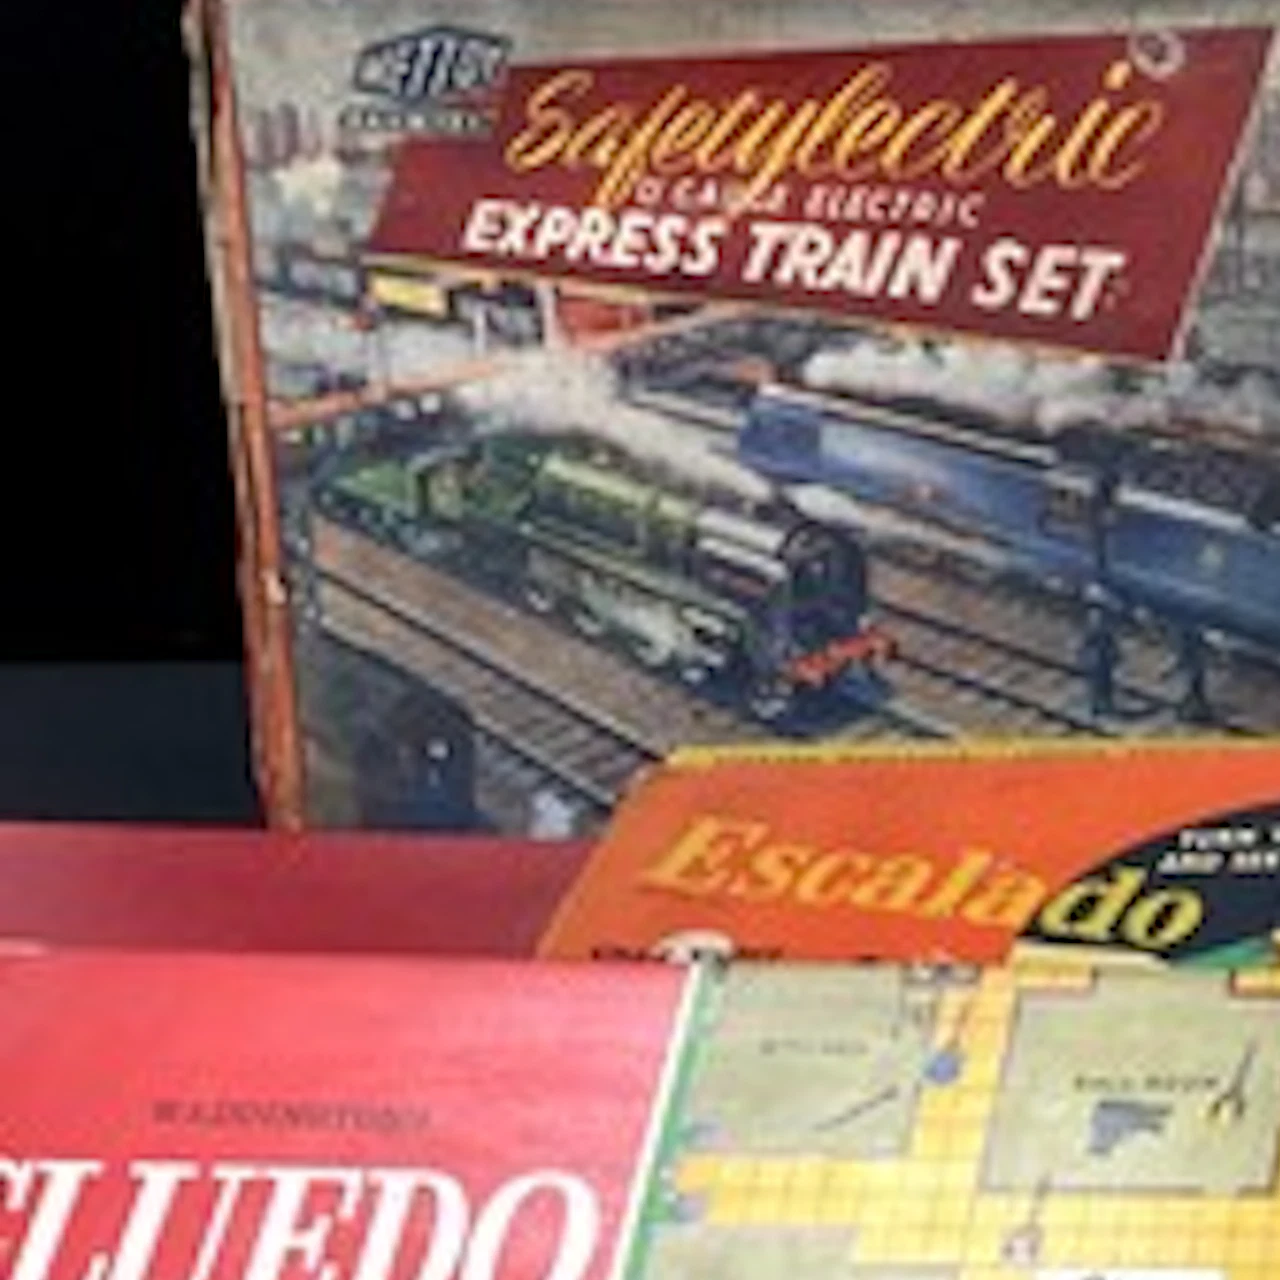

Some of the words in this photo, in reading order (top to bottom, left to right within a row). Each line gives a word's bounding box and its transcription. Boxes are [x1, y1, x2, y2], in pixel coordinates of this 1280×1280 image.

[503, 56, 1166, 210] Safetylectric
[462, 199, 726, 276] EXPRESS
[740, 220, 962, 305] TRAIN
[970, 235, 1128, 322] SET
[650, 813, 1201, 950] Escalado
